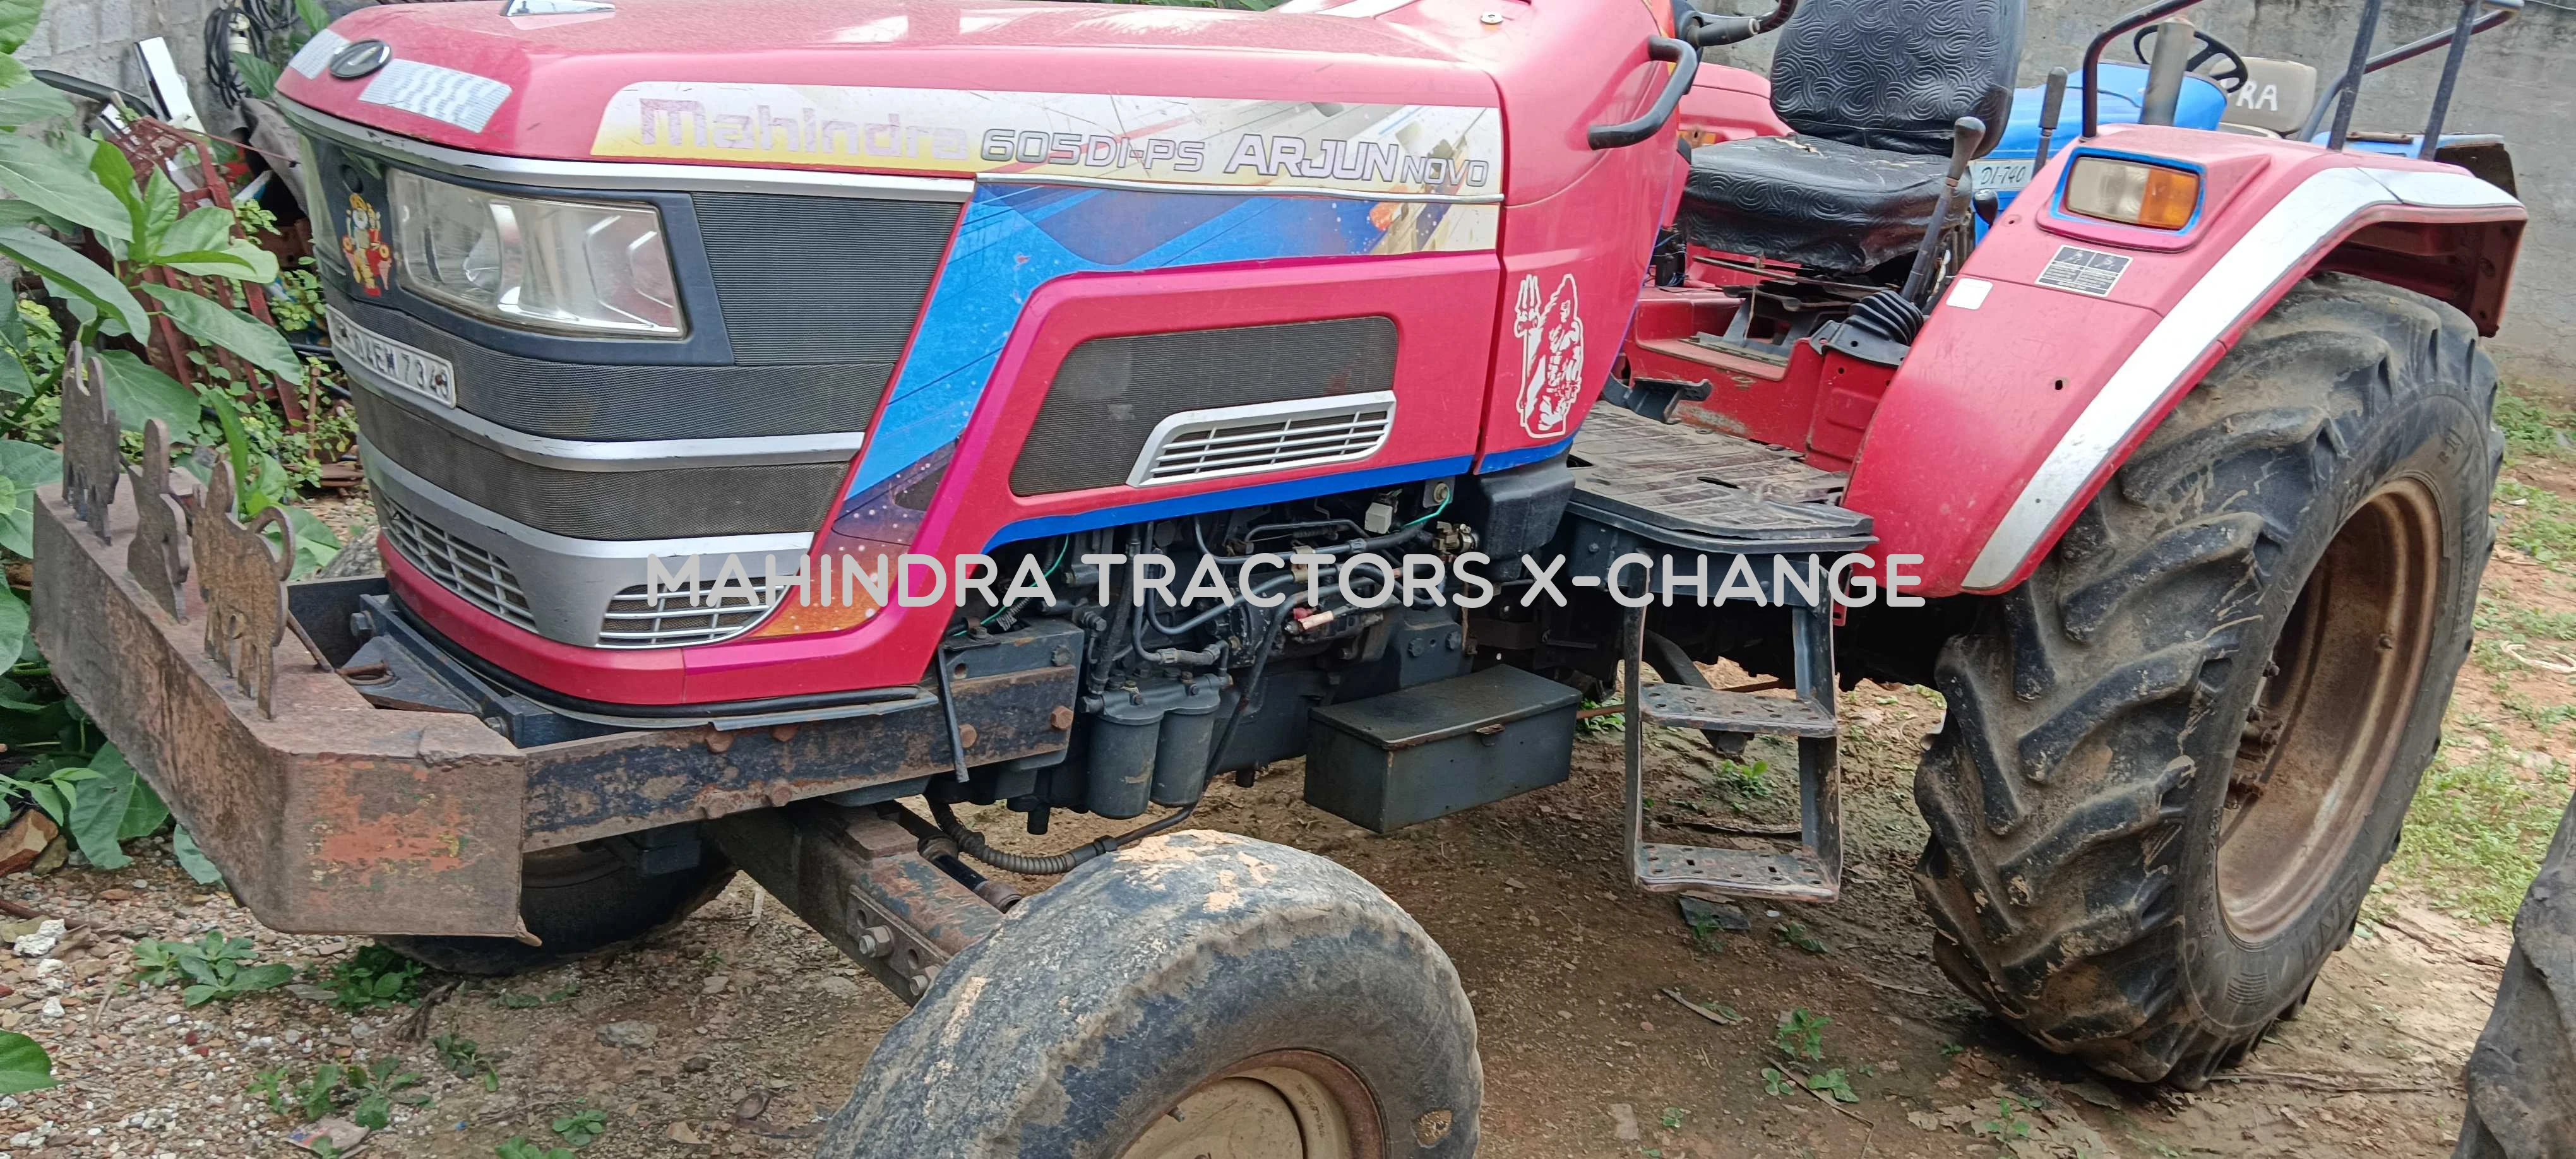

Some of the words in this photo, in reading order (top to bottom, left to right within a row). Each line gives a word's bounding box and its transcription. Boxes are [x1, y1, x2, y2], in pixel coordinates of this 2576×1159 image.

[1224, 134, 1400, 182] ARJUN
[1401, 155, 1490, 187] NOVO
[1981, 166, 2025, 184] DI-740
